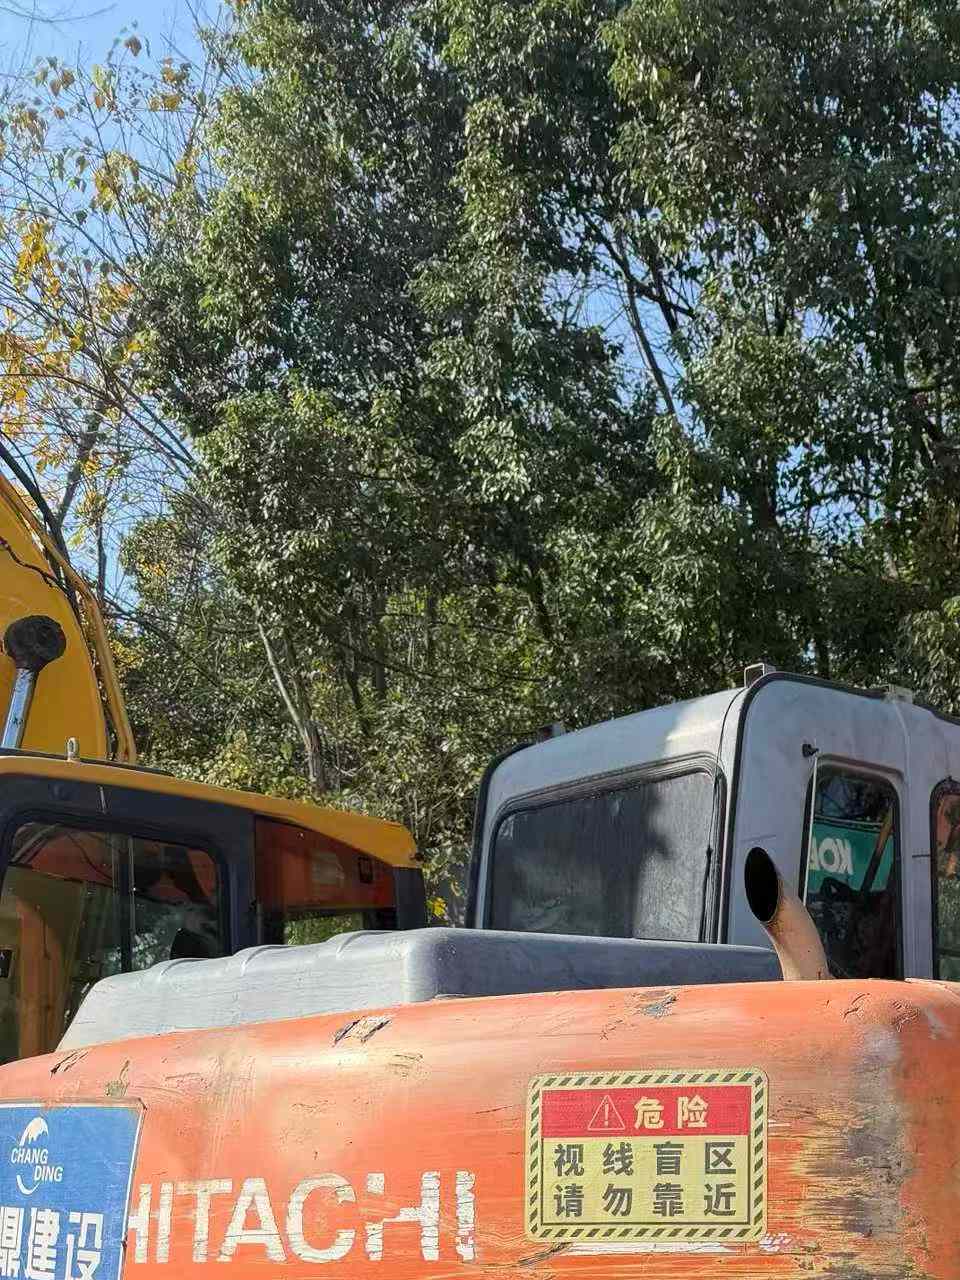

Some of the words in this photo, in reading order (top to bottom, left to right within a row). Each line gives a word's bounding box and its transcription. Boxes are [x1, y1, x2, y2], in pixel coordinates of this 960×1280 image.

[634, 1094, 709, 1129] 危险
[10, 1147, 49, 1165] CHANG
[33, 1163, 64, 1182] DING
[553, 1141, 737, 1177] 视线盲区
[553, 1182, 737, 1218] 请勿靠近
